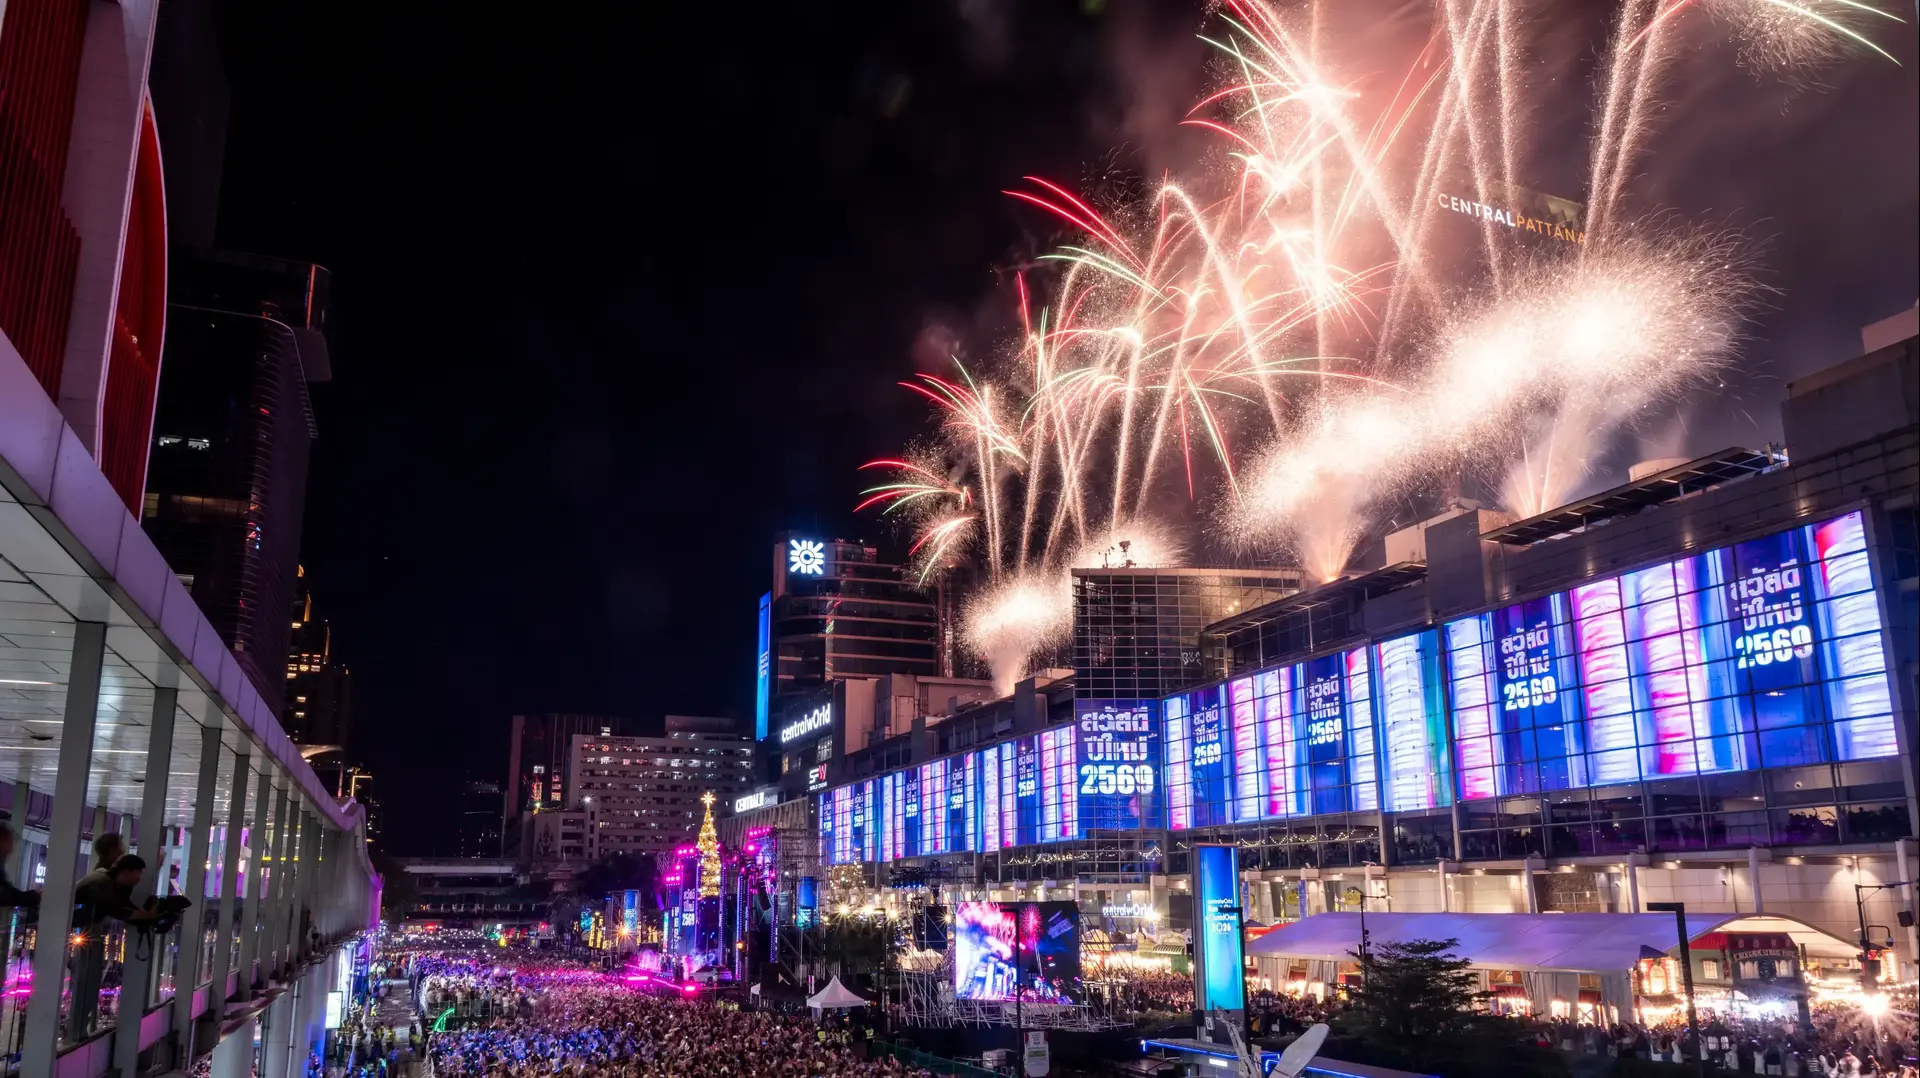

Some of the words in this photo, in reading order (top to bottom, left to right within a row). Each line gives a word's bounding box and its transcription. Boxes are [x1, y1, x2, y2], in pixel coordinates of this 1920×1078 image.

[1730, 558, 1800, 600] สวัสดี
[1734, 592, 1802, 631] ปีใหม่
[1501, 621, 1549, 654] สวัสดี
[1735, 625, 1813, 669] 2569
[1504, 649, 1549, 679] ปีใหม่
[1503, 676, 1556, 711] 2569
[782, 703, 830, 742] centralwOrld
[1081, 706, 1149, 731] สวัสดี
[1308, 718, 1343, 745] 2569
[1083, 733, 1147, 761] ปีใหม่
[1194, 743, 1221, 766] 2569
[1081, 765, 1154, 794] 2569
